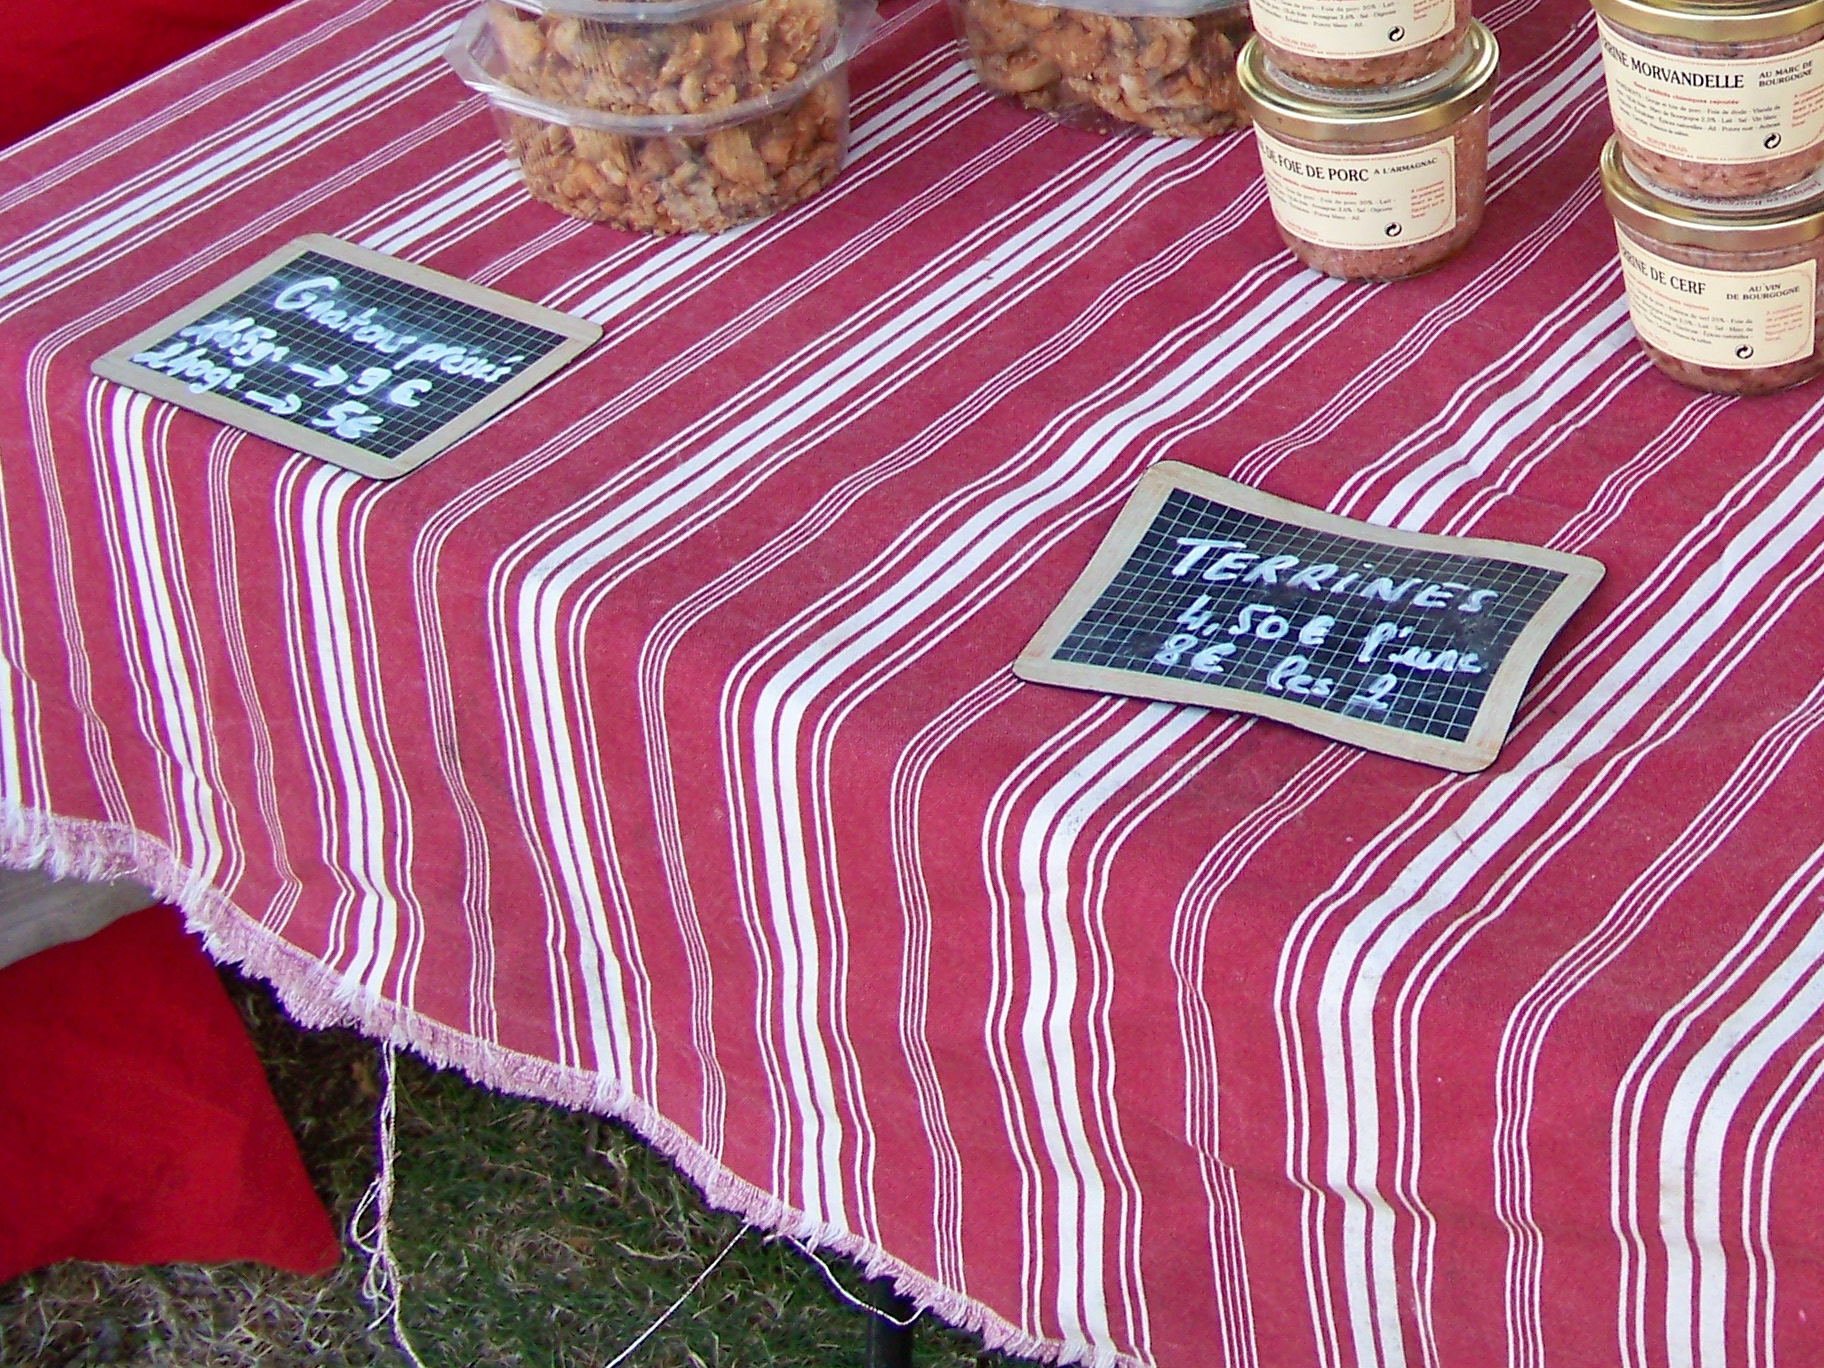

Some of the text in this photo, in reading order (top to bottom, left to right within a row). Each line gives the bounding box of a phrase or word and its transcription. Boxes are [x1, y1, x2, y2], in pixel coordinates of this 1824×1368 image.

[1630, 56, 1745, 89] MORVANDELLE
[1758, 71, 1772, 79] AU
[1775, 65, 1800, 77] MARC
[1758, 69, 1813, 88] BOURGOGNE
[1278, 154, 1304, 176] FOIE
[1305, 165, 1325, 180] DE
[1328, 168, 1369, 182] PORC
[1382, 157, 1438, 175] L'ARMAGNAC
[1650, 266, 1706, 296] DE CERF
[1748, 283, 1781, 293] AU VIN
[1742, 286, 1801, 301] BOURGOGNE
